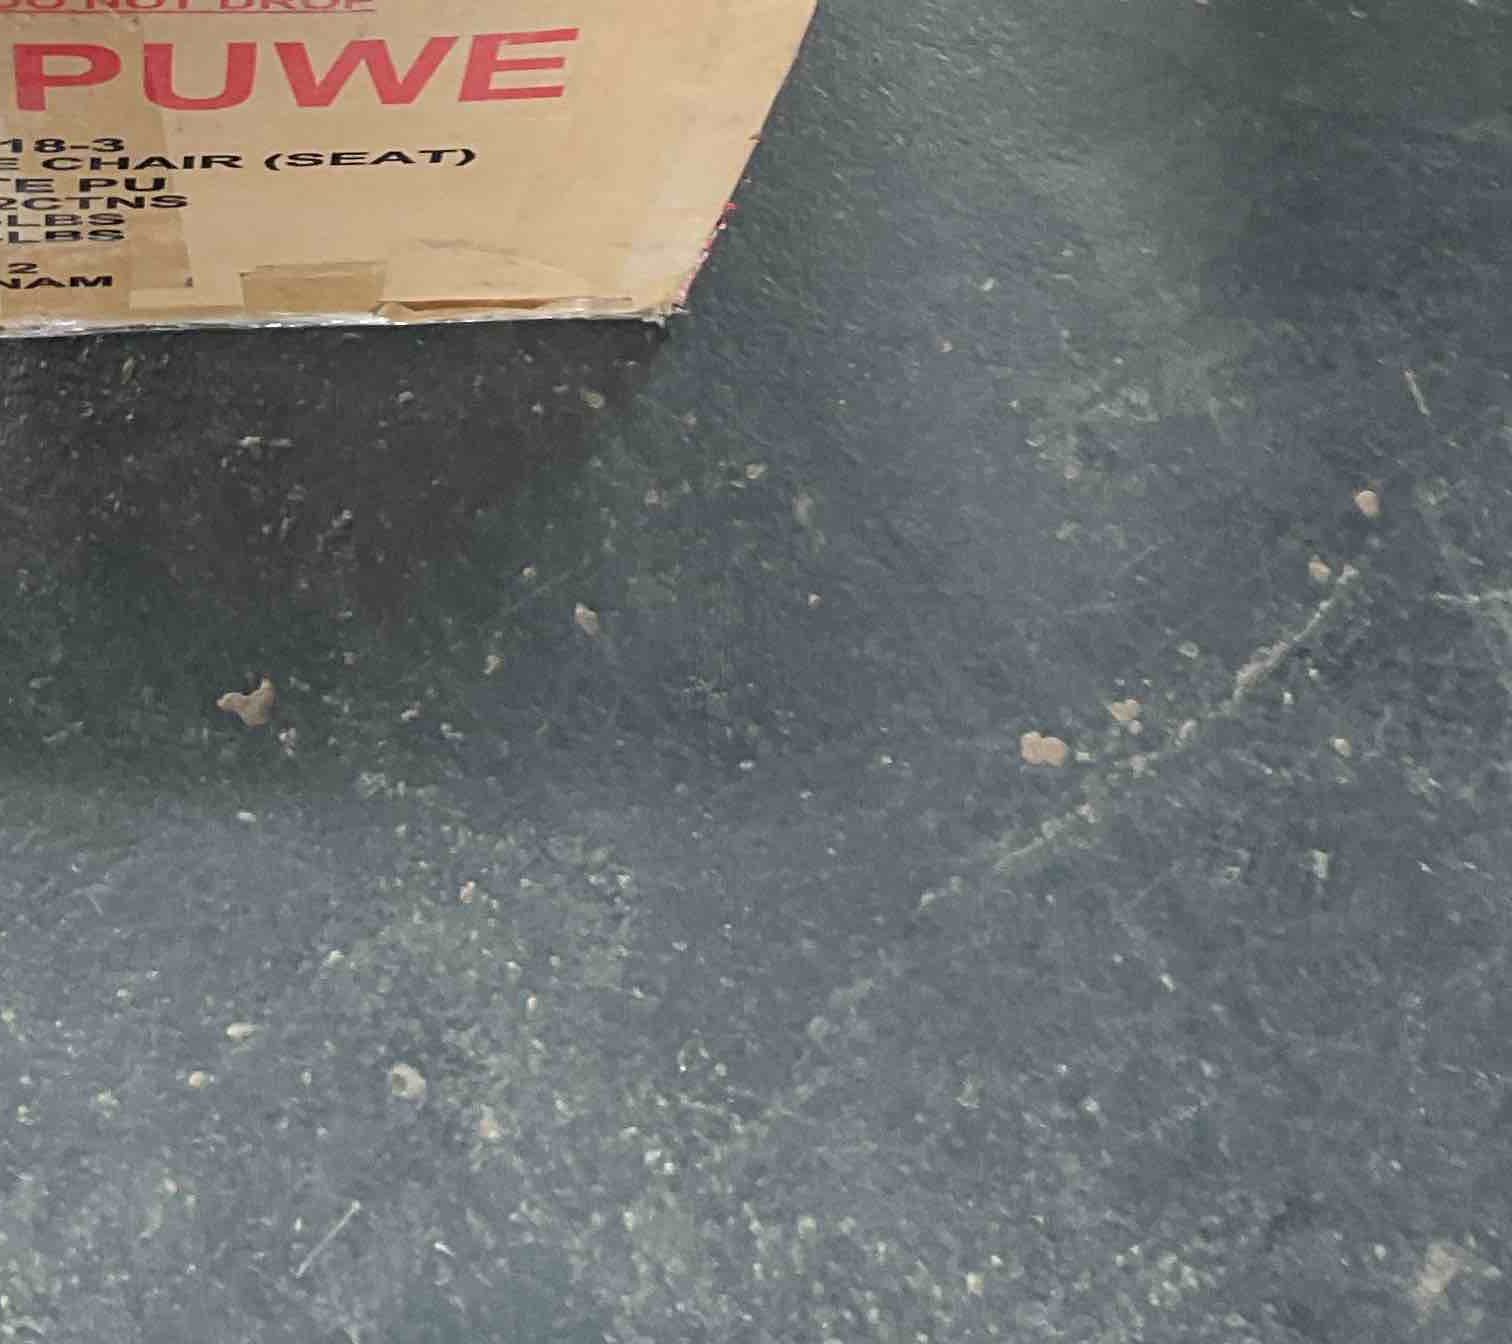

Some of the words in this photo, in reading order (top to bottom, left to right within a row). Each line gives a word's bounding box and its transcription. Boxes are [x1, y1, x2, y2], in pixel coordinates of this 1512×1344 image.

[41, 154, 244, 171] CHAIR
[264, 149, 476, 171] (SEAT)
[78, 177, 167, 193] PU
[7, 263, 38, 274] 2
